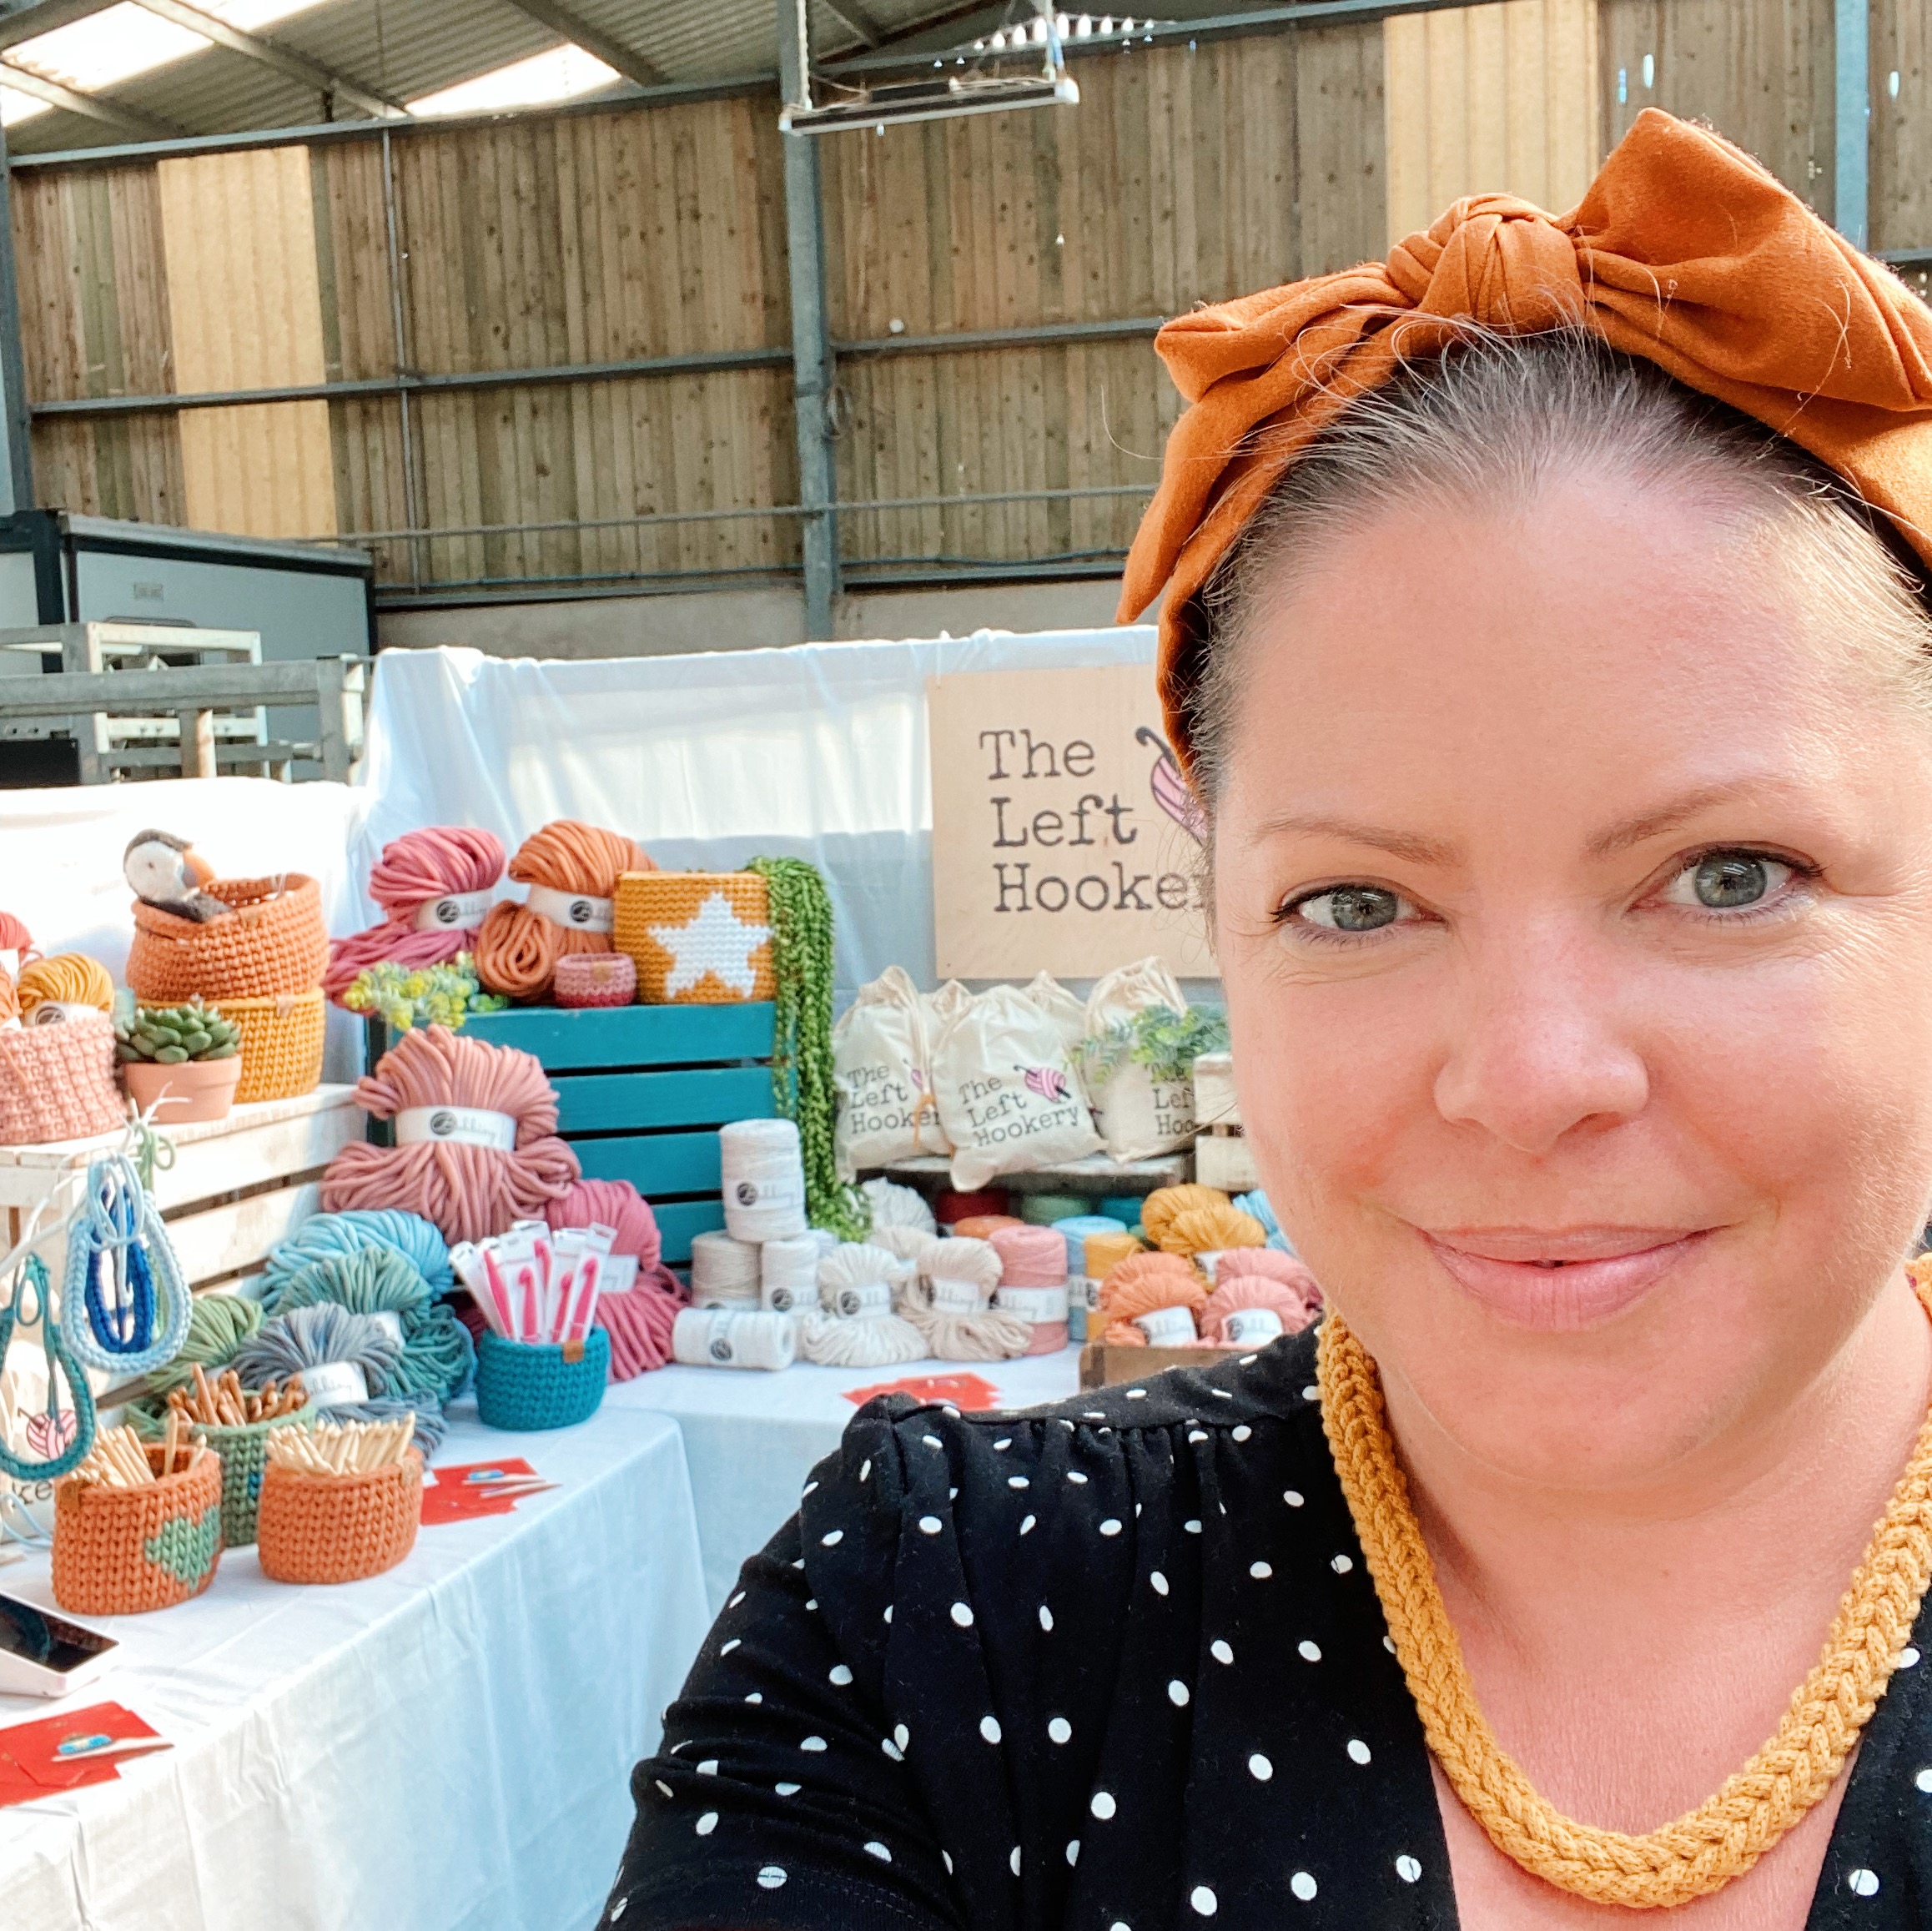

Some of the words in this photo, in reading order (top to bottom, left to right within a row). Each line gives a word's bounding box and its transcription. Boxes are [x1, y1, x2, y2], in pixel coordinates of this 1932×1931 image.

[979, 728, 1095, 781] The
[989, 793, 1139, 848] Left
[847, 1064, 890, 1089] The
[958, 1076, 1003, 1105] The
[850, 1082, 908, 1109] Left
[1152, 1087, 1195, 1109] Lef
[968, 1093, 1028, 1129] Left
[1155, 1114, 1198, 1135] Hoo
[973, 1105, 1079, 1147] Hookery
